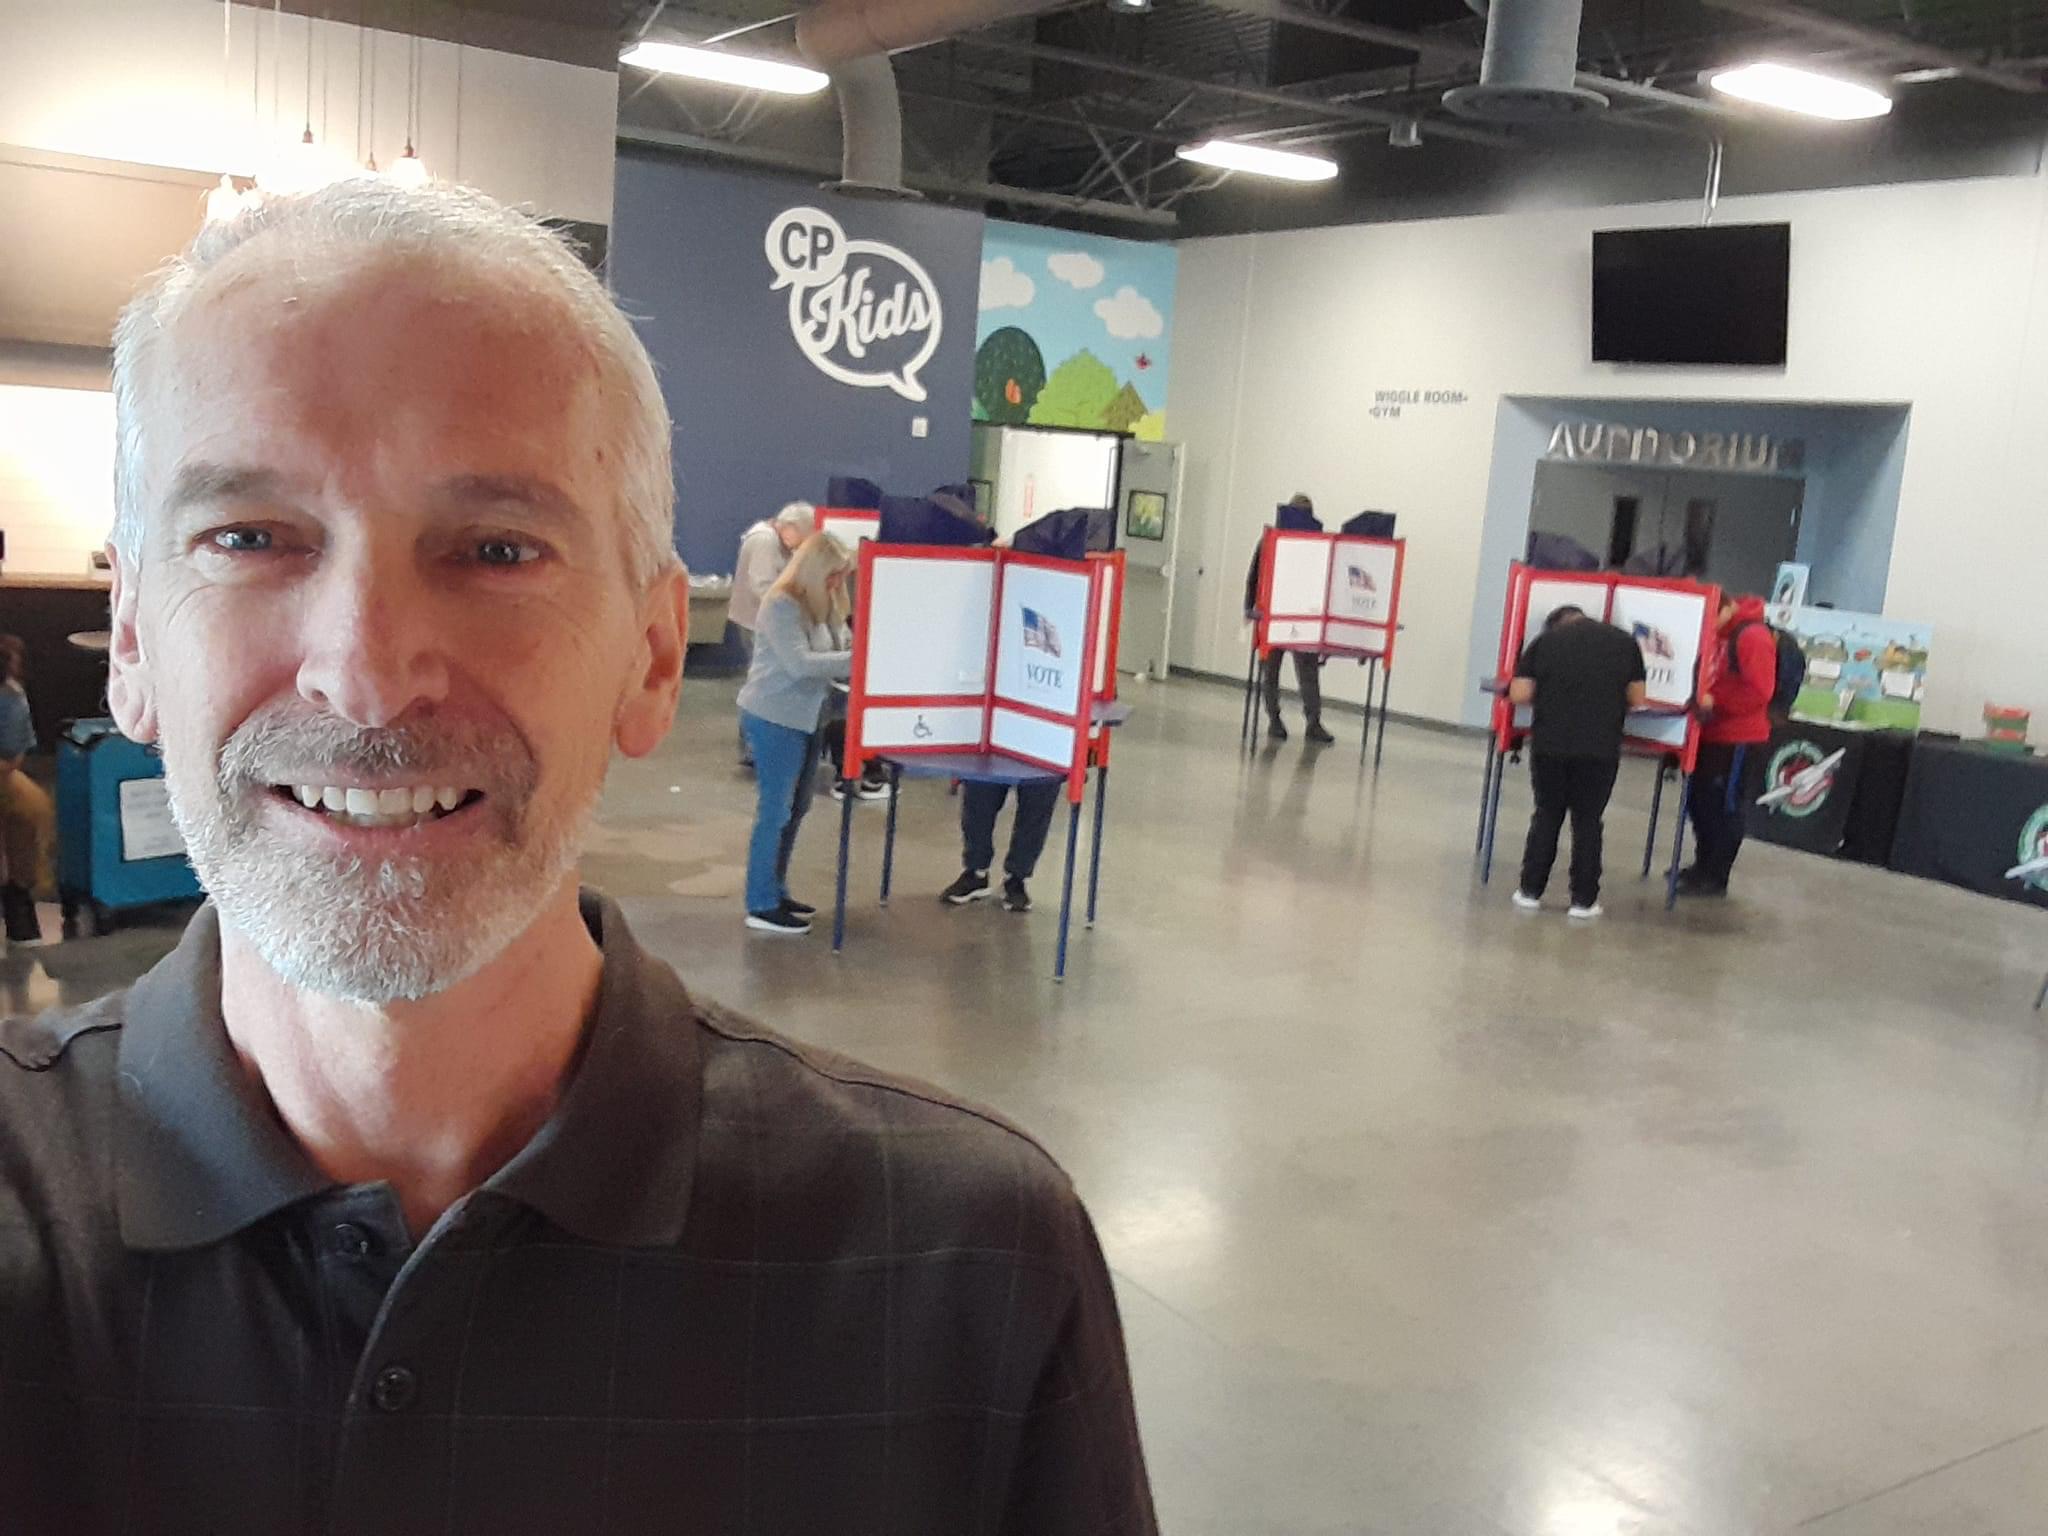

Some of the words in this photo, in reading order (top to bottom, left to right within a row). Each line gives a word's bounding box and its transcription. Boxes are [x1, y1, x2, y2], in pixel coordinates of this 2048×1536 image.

[780, 221, 834, 271] CP
[803, 267, 931, 358] Kids
[1373, 406, 1400, 417] GYM
[1027, 664, 1063, 688] VOTE
[1647, 666, 1676, 685] OTE
